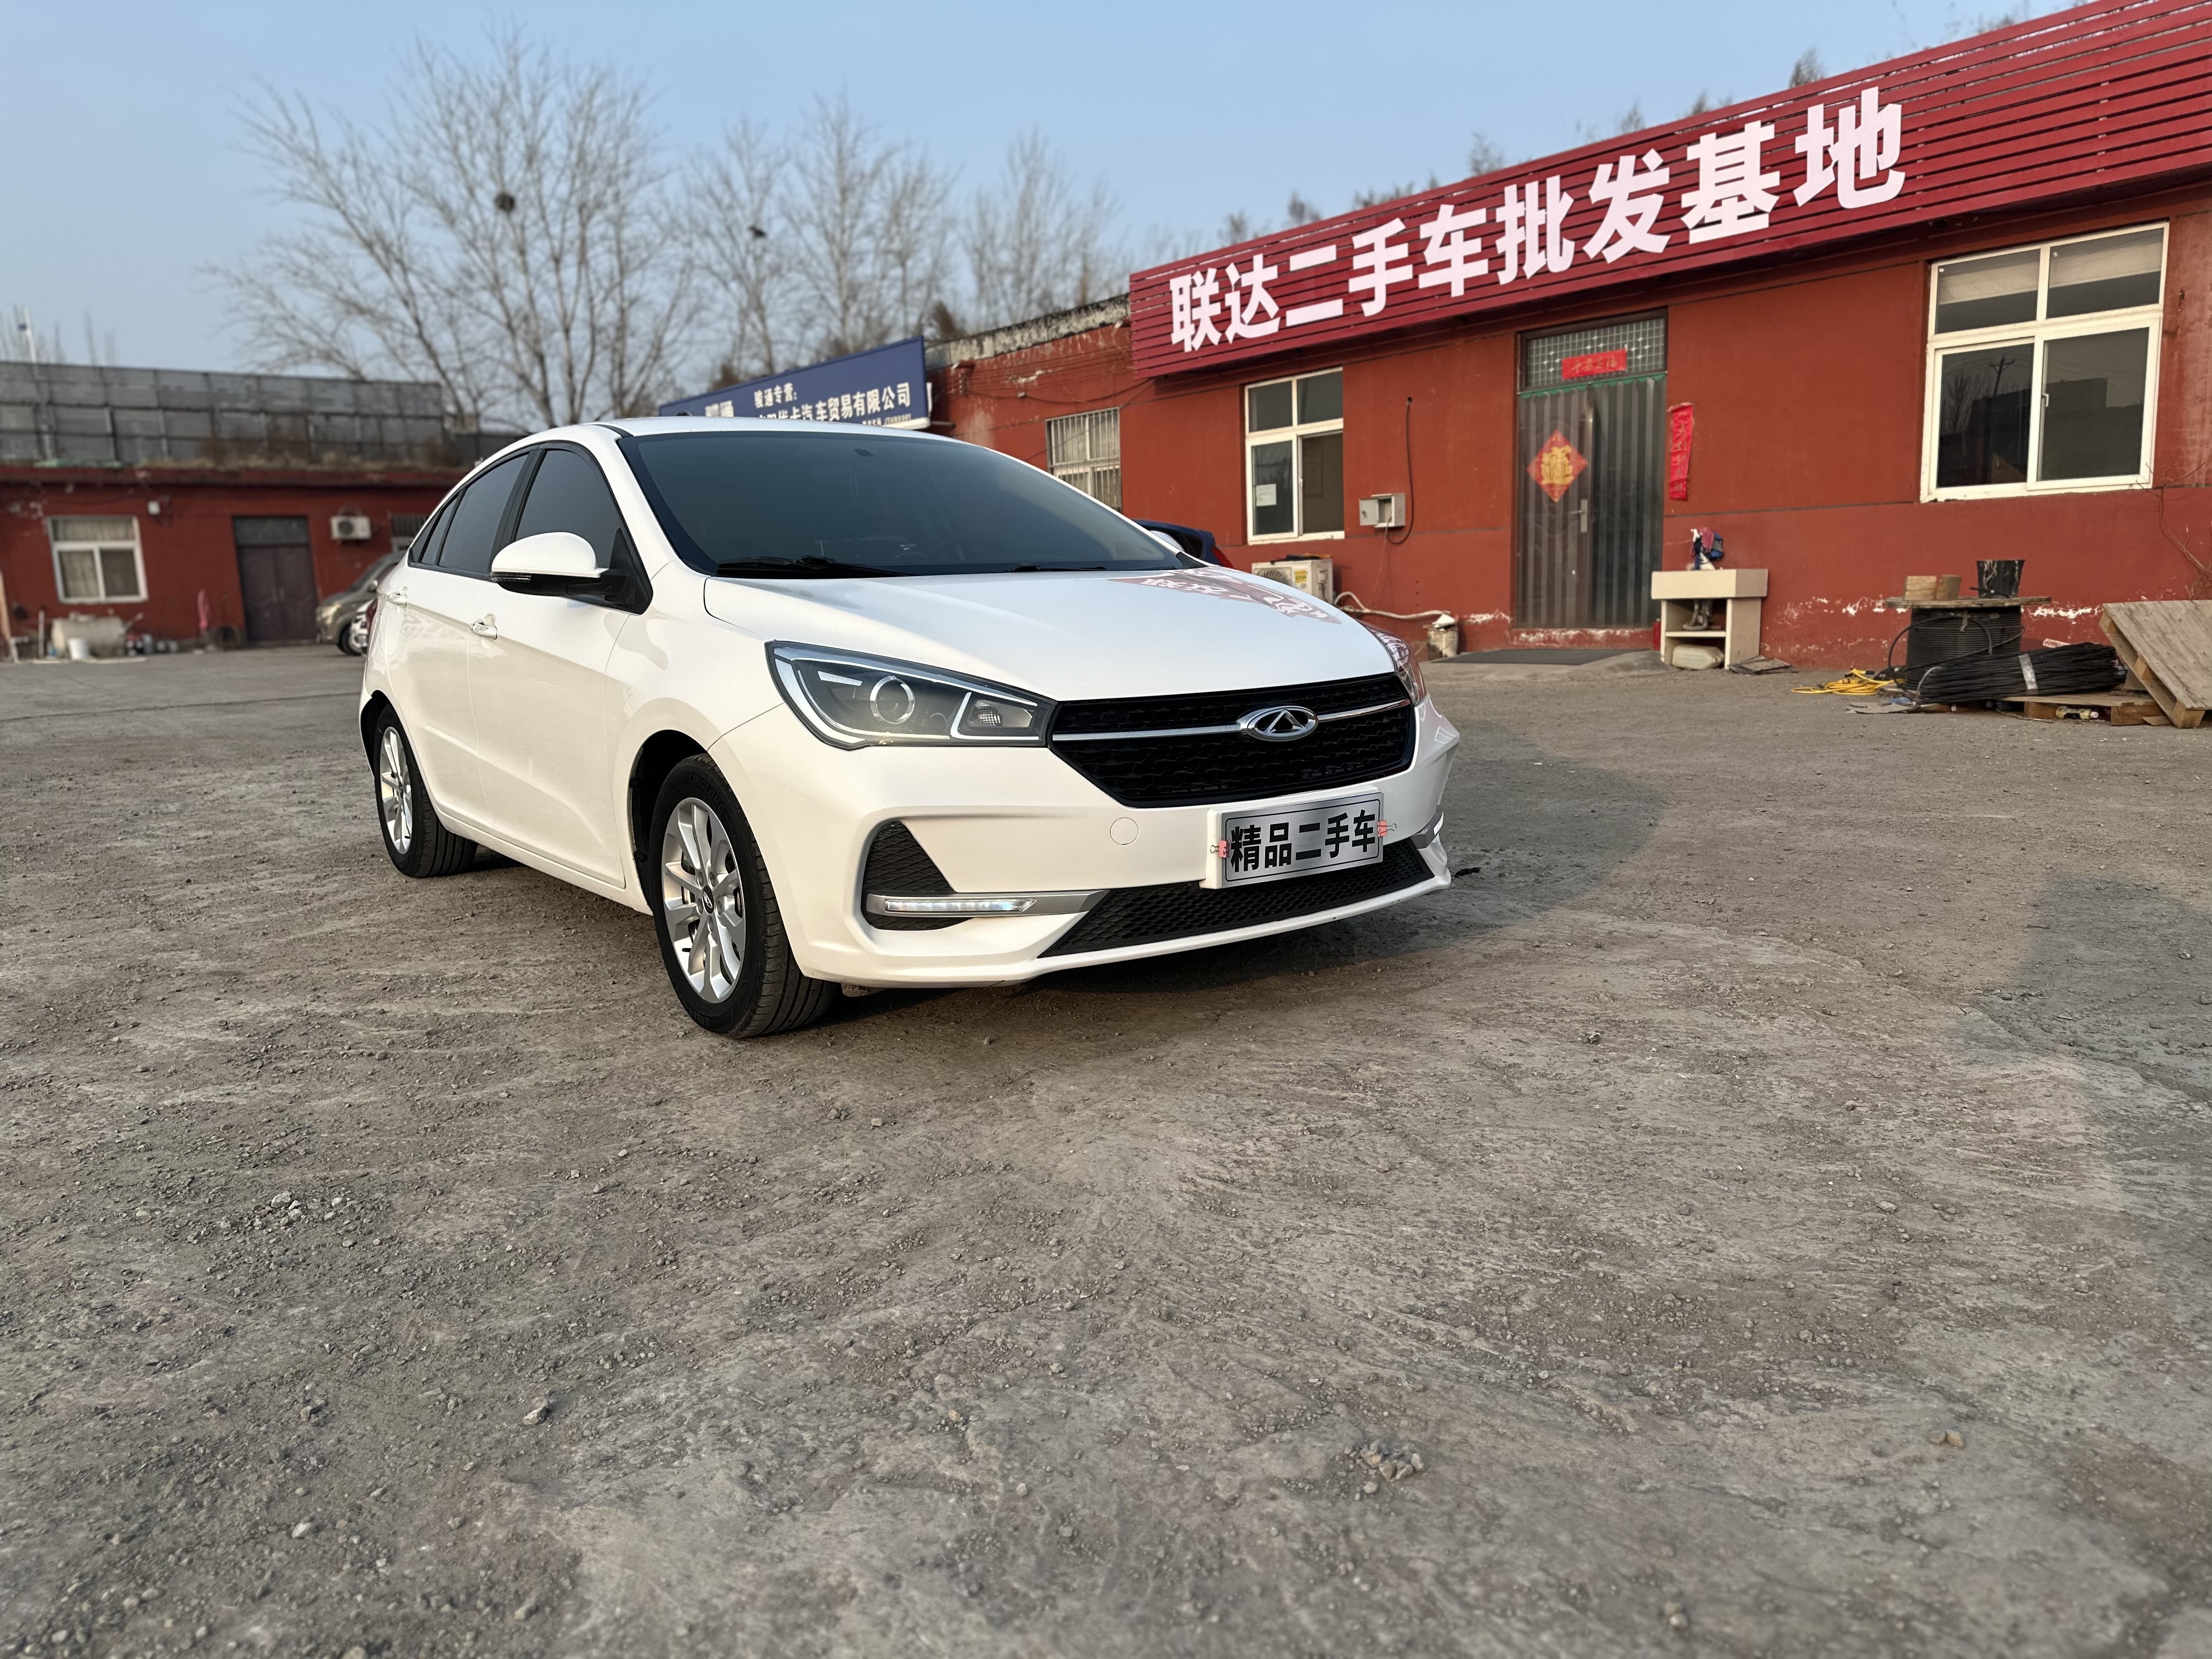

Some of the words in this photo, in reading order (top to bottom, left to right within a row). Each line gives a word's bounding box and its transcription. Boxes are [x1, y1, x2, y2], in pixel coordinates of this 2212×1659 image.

[1170, 87, 1906, 352] 联达二手车批发基地
[689, 772, 725, 814] LINGLONG
[1230, 809, 1376, 872] 精品二手车
